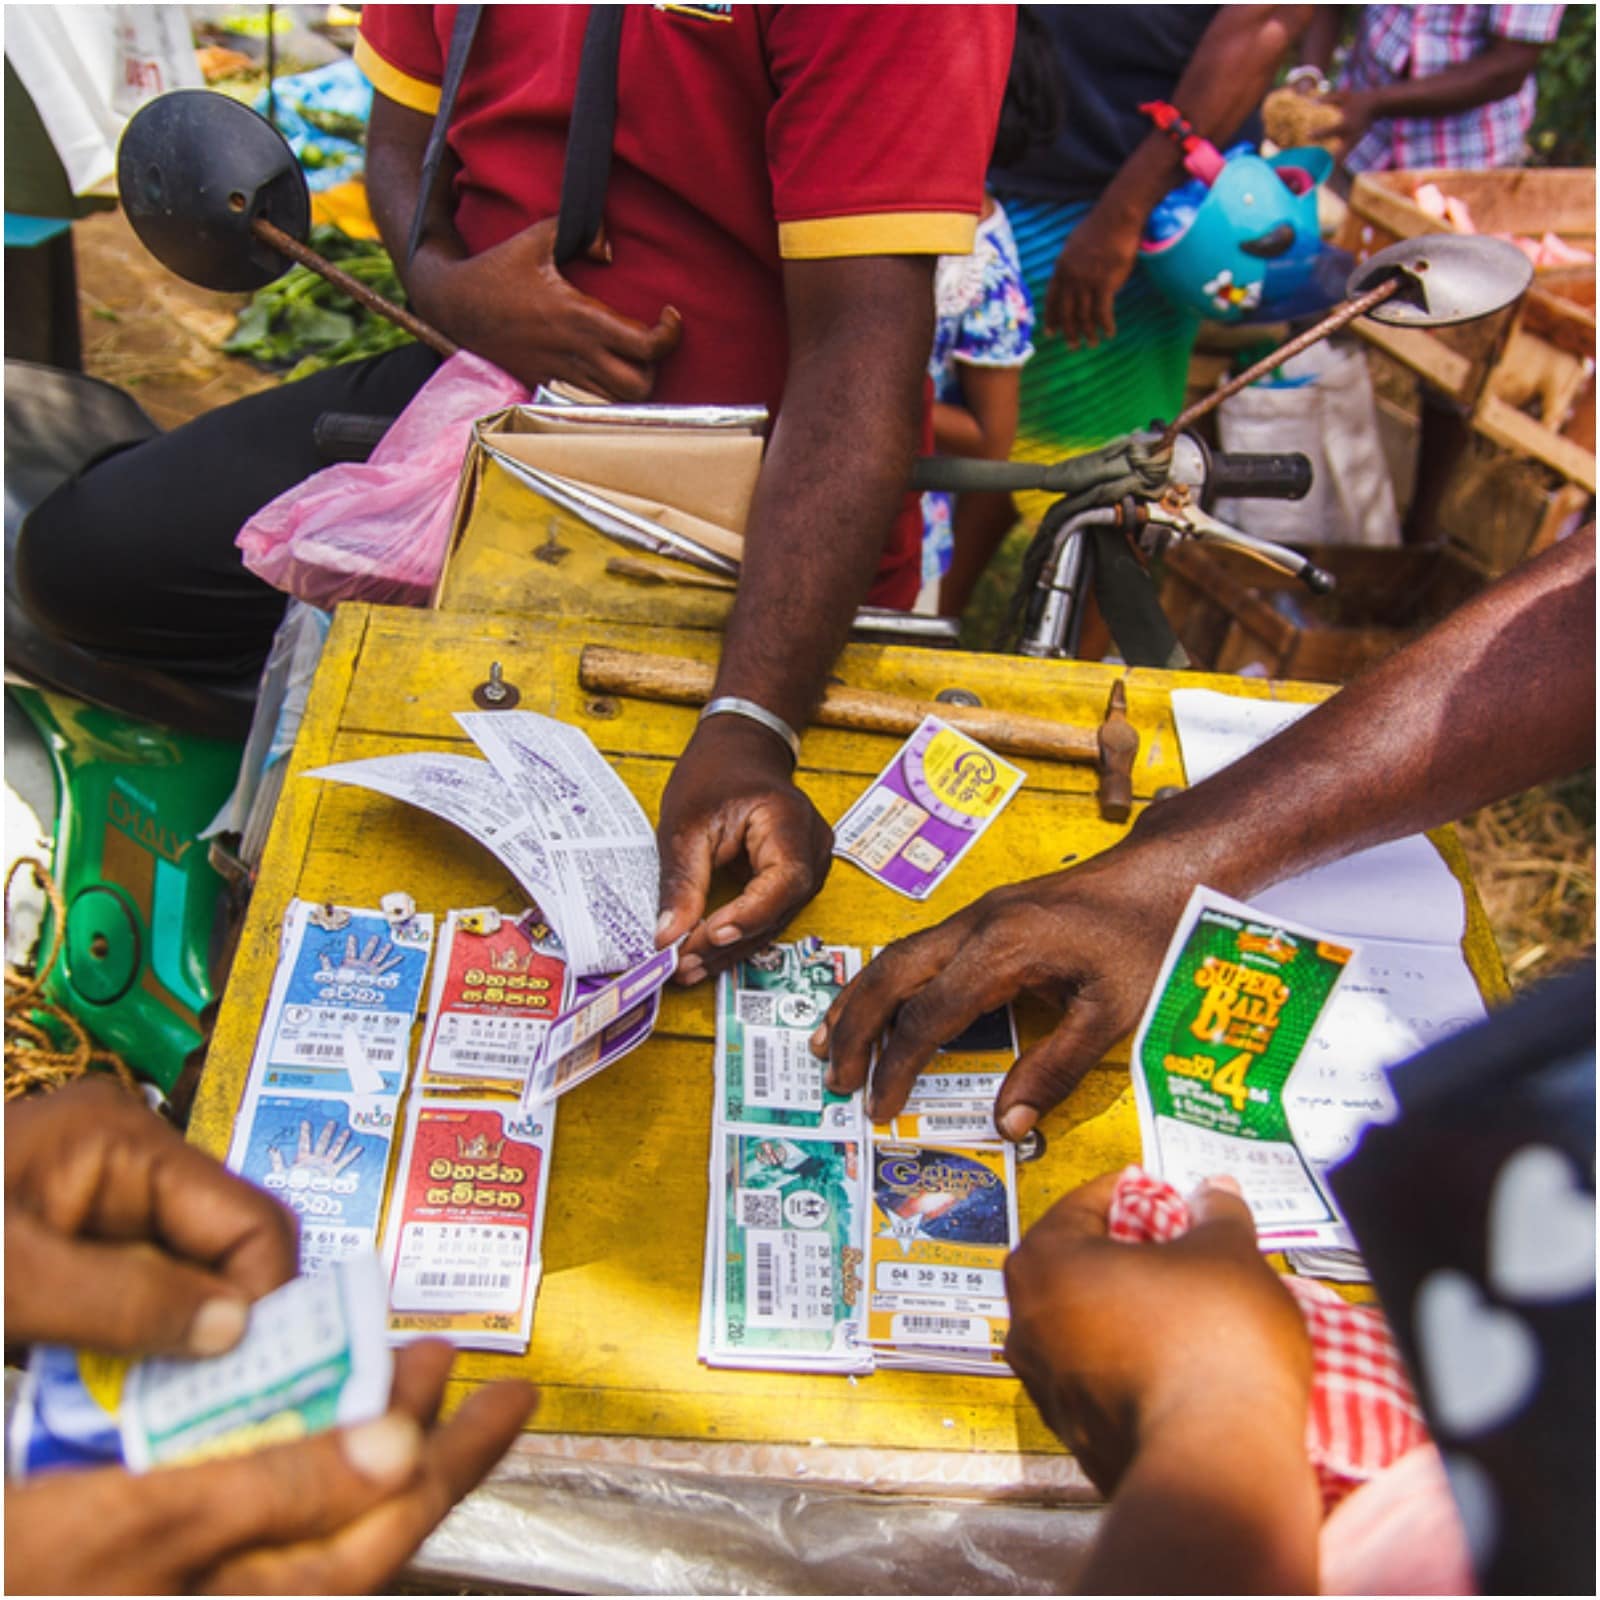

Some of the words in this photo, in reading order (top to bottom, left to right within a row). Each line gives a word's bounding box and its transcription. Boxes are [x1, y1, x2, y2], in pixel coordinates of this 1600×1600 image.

[1194, 957, 1290, 1005] SUPER
[1190, 983, 1280, 1042] BALL
[1211, 1051, 1253, 1111] 4
[426, 1181, 522, 1209] සම්පත
[429, 1158, 525, 1185] මහජන
